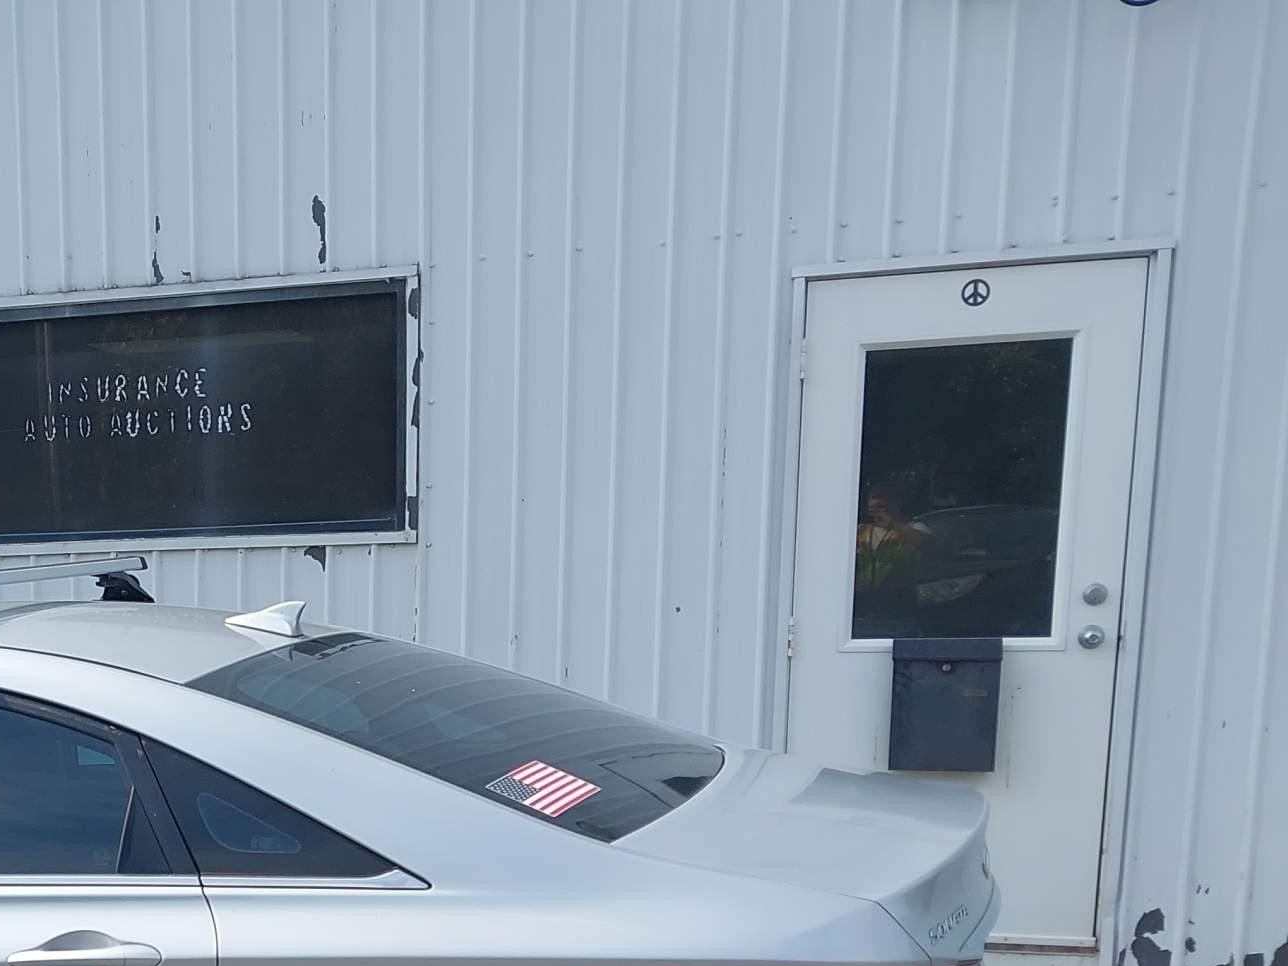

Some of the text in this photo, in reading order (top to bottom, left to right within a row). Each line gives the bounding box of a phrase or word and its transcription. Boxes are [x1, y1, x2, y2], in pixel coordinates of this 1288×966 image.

[48, 368, 208, 403] INSURANCE
[24, 403, 252, 443] AUTO AUCTIONS
